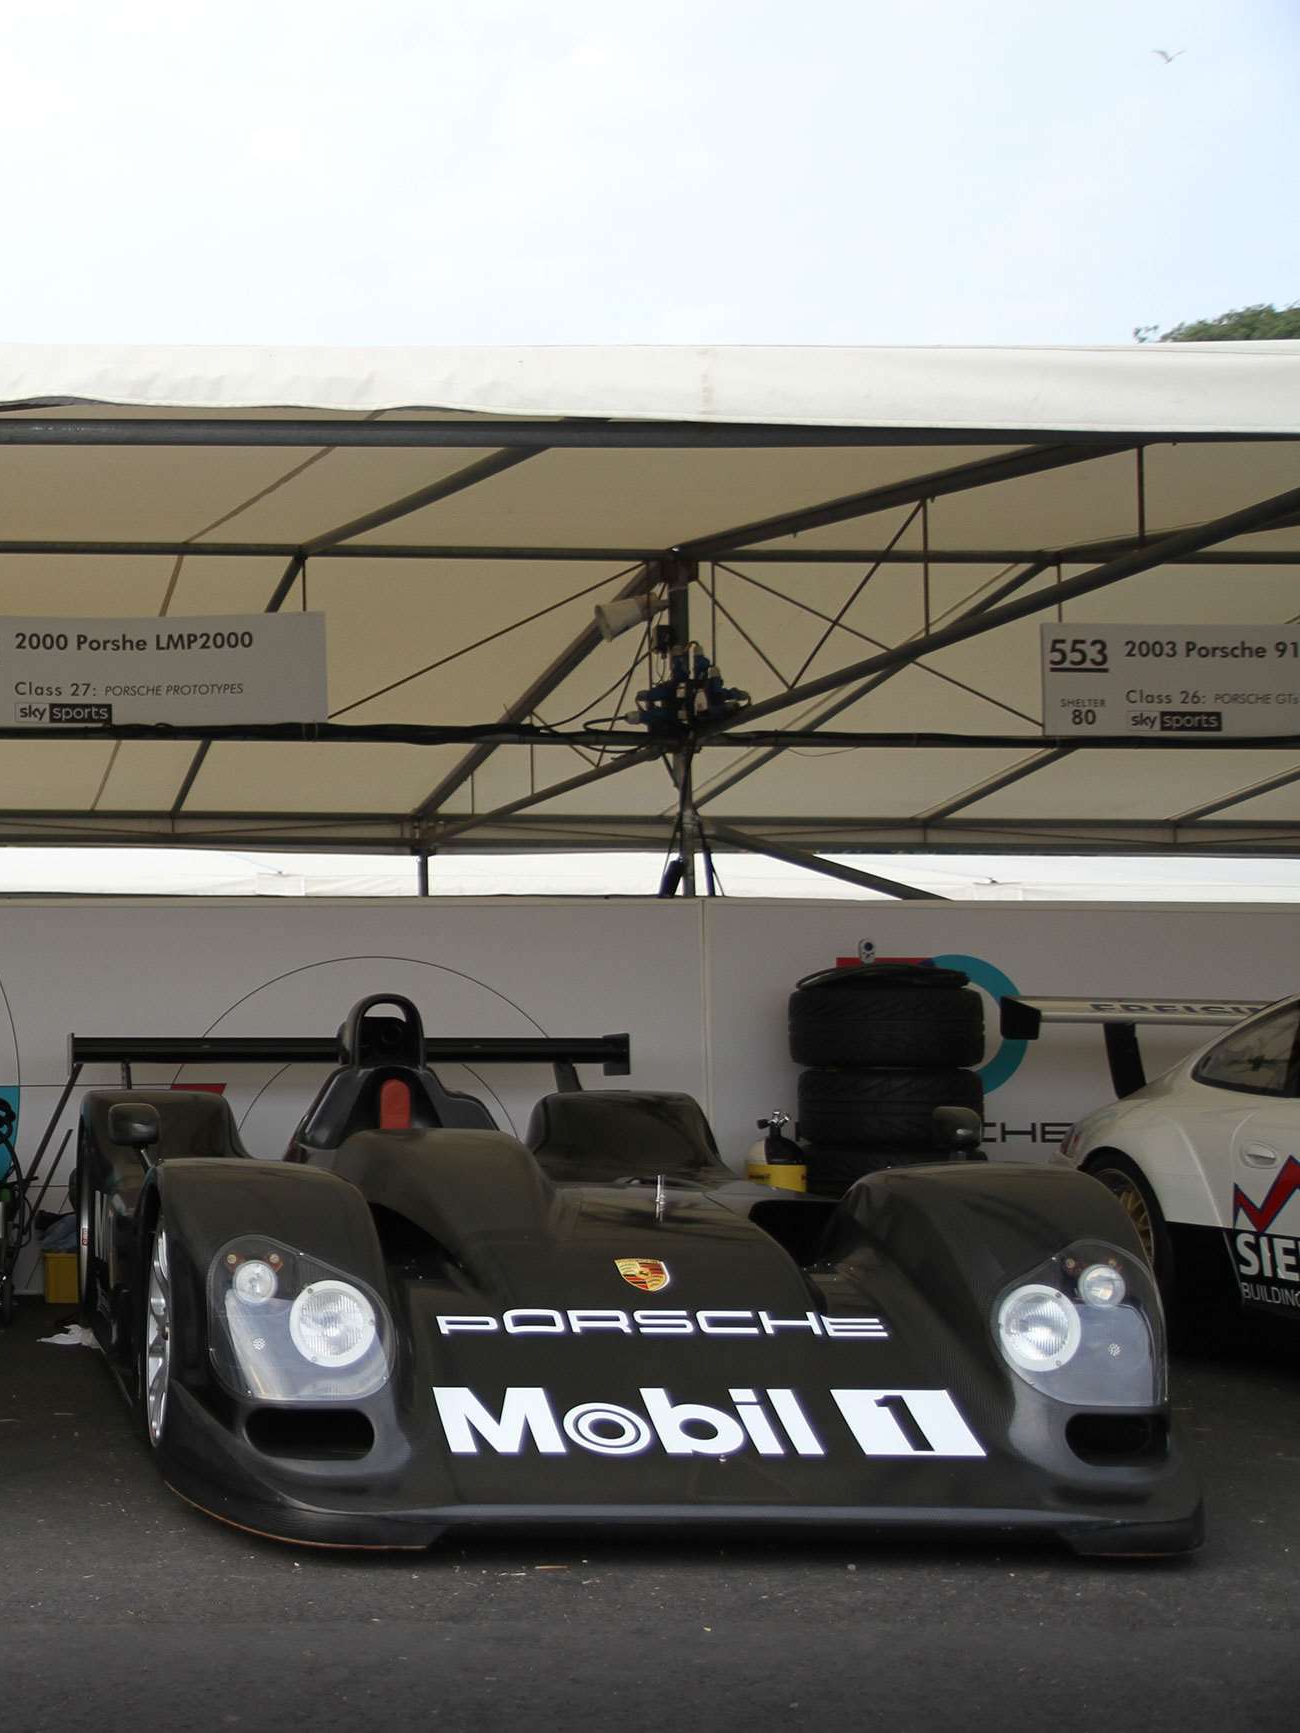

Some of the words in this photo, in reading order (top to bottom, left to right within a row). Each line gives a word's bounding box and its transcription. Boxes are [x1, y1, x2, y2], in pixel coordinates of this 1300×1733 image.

[15, 633, 69, 651] 2000
[76, 633, 148, 652] Porshe
[155, 631, 254, 651] LMP2000
[1124, 640, 1177, 658] 2003
[1185, 640, 1267, 659] Porsche
[1050, 639, 1109, 666] 553
[14, 681, 63, 698] Class
[70, 682, 97, 697] 27:
[105, 683, 163, 697] PORSCHE
[165, 682, 244, 696] PROTOTYPES
[1125, 689, 1173, 704] Class
[1179, 690, 1206, 704] 26:
[1214, 693, 1272, 705] PORSCHE
[19, 703, 47, 721] sky
[52, 703, 110, 721] sports
[1060, 698, 1106, 708] SHELTER
[1071, 710, 1097, 725] 80
[1131, 713, 1157, 730] sky
[1163, 713, 1219, 730] sports
[1236, 1232, 1300, 1282] SIE
[436, 1308, 889, 1338] PORSCHE
[432, 1387, 824, 1454] Mobil
